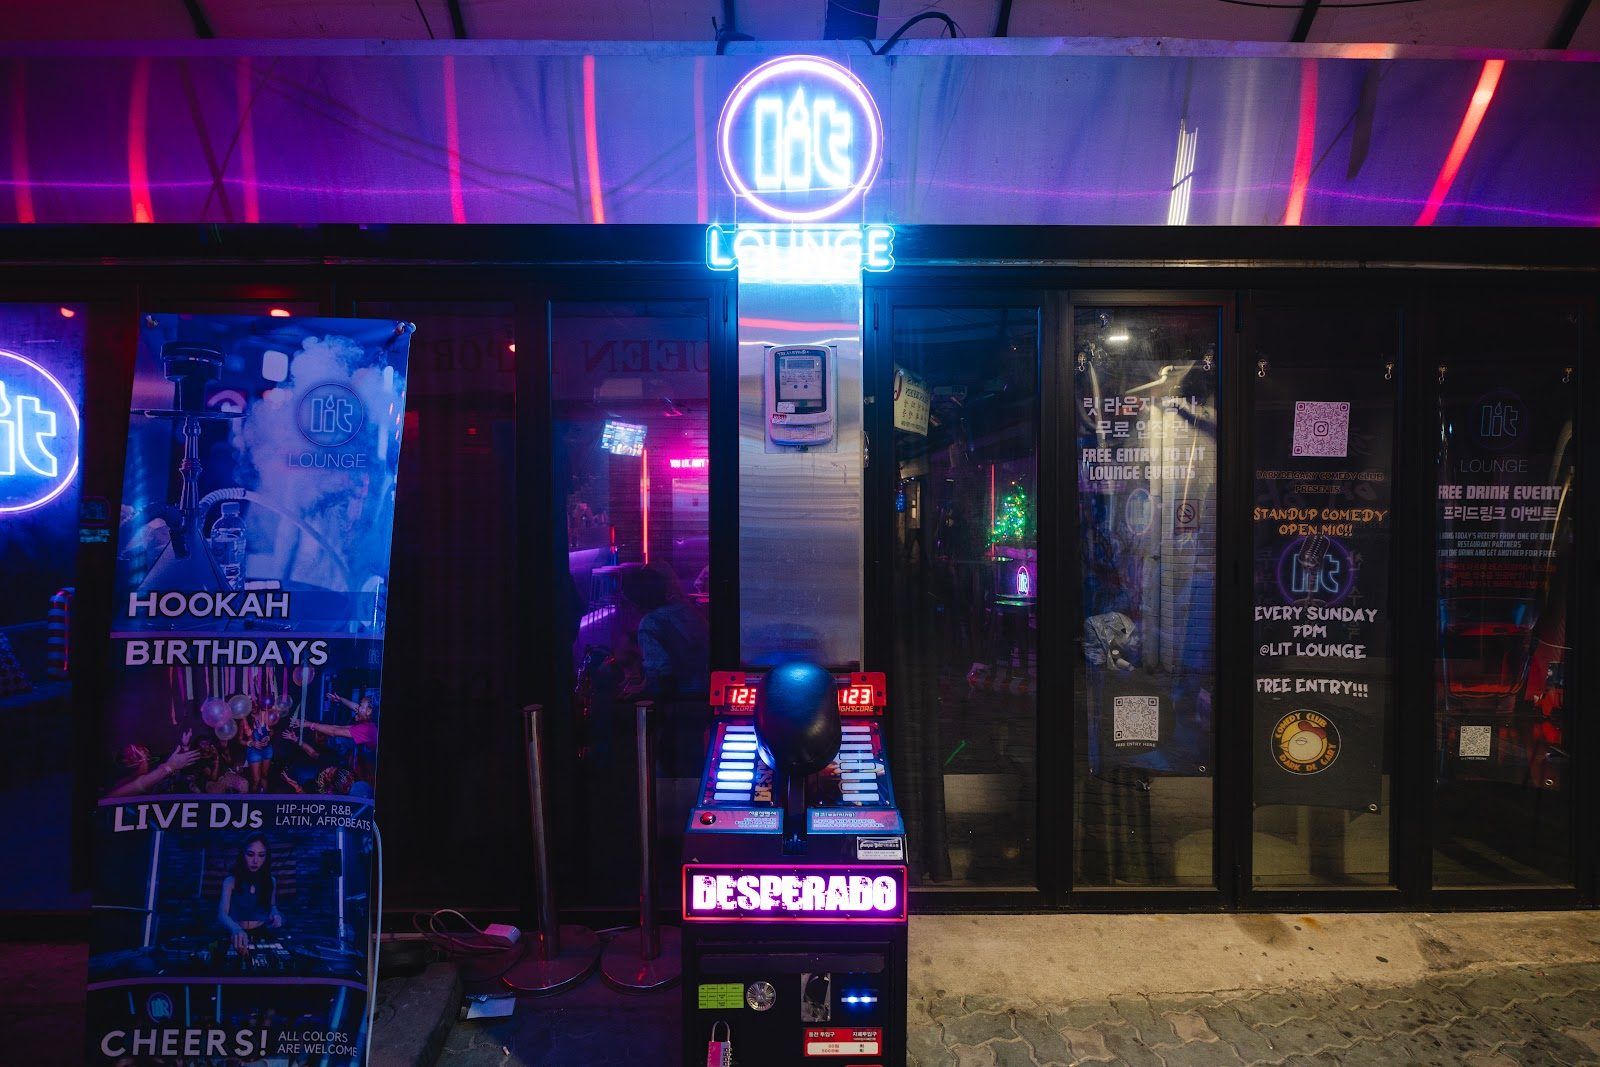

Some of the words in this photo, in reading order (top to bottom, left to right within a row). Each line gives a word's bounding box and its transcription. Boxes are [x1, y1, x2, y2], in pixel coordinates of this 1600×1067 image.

[709, 228, 891, 267] LOUNGE
[311, 394, 352, 433] lit
[1104, 395, 1155, 416] 라운지
[1095, 420, 1130, 440] 무료
[288, 452, 367, 469] LOUNGE
[1082, 448, 1112, 463] FREE
[1116, 447, 1159, 462] ENTRY
[1089, 465, 1140, 481] LOUNGE
[1460, 459, 1529, 473] LOUNGE
[1319, 471, 1358, 480] COMEDY
[1438, 485, 1462, 499] FREE
[1466, 485, 1510, 500] DRINK
[1513, 485, 1562, 500] EVENT
[1253, 507, 1319, 521] STANDUP
[1321, 507, 1389, 522] COMEDY
[1443, 505, 1507, 521] 프리드링크
[1511, 505, 1558, 521] 이벤트
[1278, 523, 1318, 536] OPEN
[1321, 523, 1354, 537] MIC!!
[1499, 532, 1517, 540] FROM
[128, 592, 289, 618] HOOKAH
[1254, 605, 1303, 622] EVERY
[1306, 606, 1378, 623] SUNDAY
[126, 639, 328, 667] BIRTHDAYS
[1259, 642, 1293, 656] @LIT
[1296, 642, 1367, 660] LOUNGE
[1256, 677, 1292, 694] FREE
[1295, 678, 1369, 698] ENTRY!!!
[843, 688, 871, 705] 123
[1275, 712, 1301, 739] COMEDY
[1305, 712, 1328, 728] CLUB
[114, 802, 199, 832] LIVE
[209, 802, 263, 828] DJs
[276, 804, 328, 817] HIP-HOP,
[331, 804, 353, 816] R&B,
[275, 815, 313, 827] LATIN,
[316, 816, 371, 831] AFROBEATS
[692, 874, 897, 911] DESPERADO
[100, 1028, 268, 1057] CHEERS!
[278, 1031, 299, 1042] ALL
[302, 1031, 348, 1043] COLORS
[277, 1043, 300, 1054] ARE
[304, 1043, 357, 1057] WELCOME
